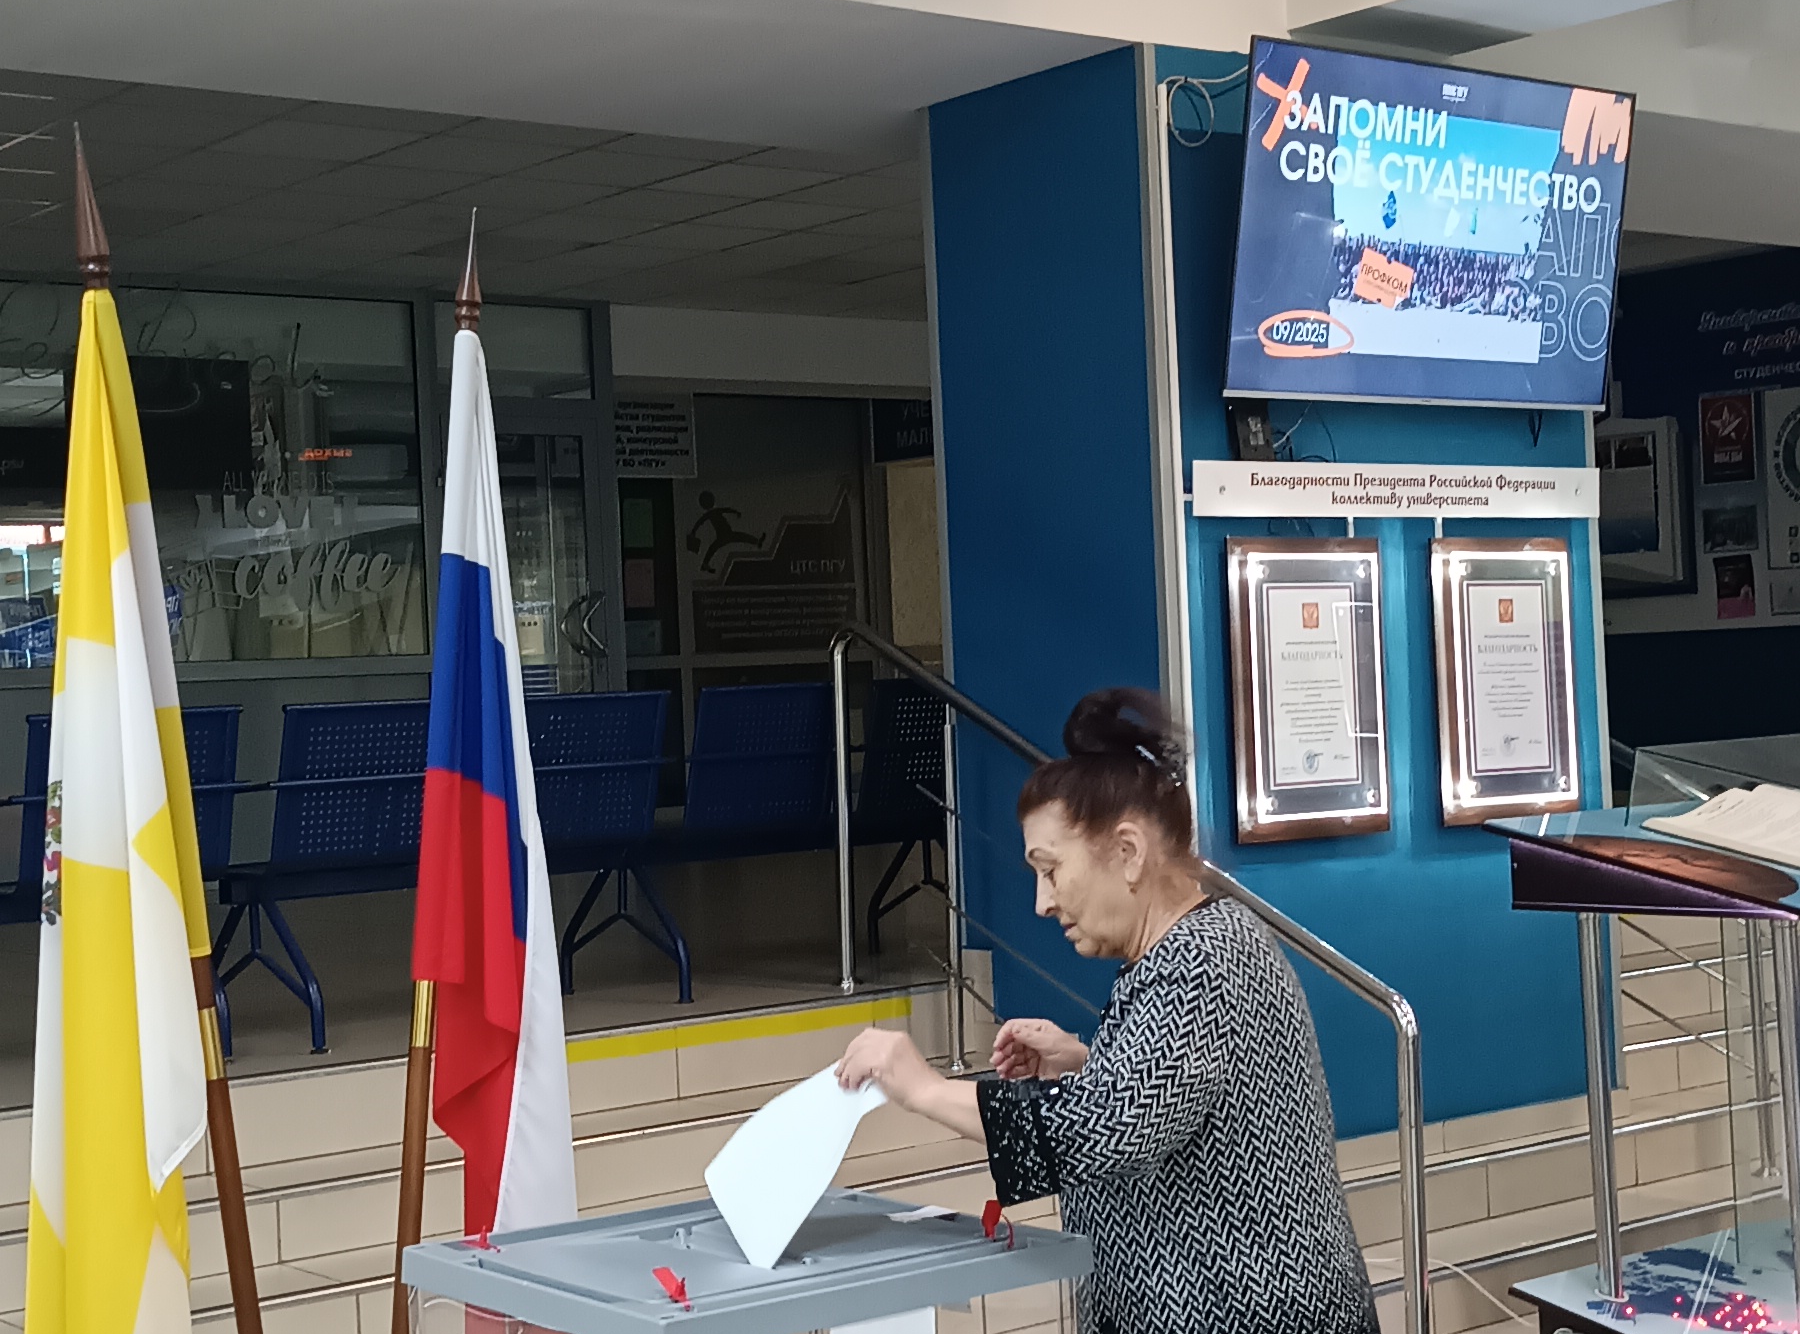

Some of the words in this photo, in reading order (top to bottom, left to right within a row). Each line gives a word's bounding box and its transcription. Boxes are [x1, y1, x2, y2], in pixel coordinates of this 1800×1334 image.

[1283, 90, 1449, 149] ЗАПОМНИ
[1280, 140, 1371, 188] СВОЁ
[1378, 154, 1602, 213] СТУДЕНЧЕСТВО
[1361, 263, 1408, 294] ПРОФКОМ
[1272, 320, 1328, 345] 09/2025
[1250, 472, 1351, 490] Благодарности
[1353, 473, 1426, 491] Президента
[1428, 475, 1494, 490] Российской
[1495, 475, 1557, 493] Федерации
[1331, 492, 1404, 509] коллективу
[1406, 493, 1490, 509] университета
[234, 539, 402, 613] coffee
